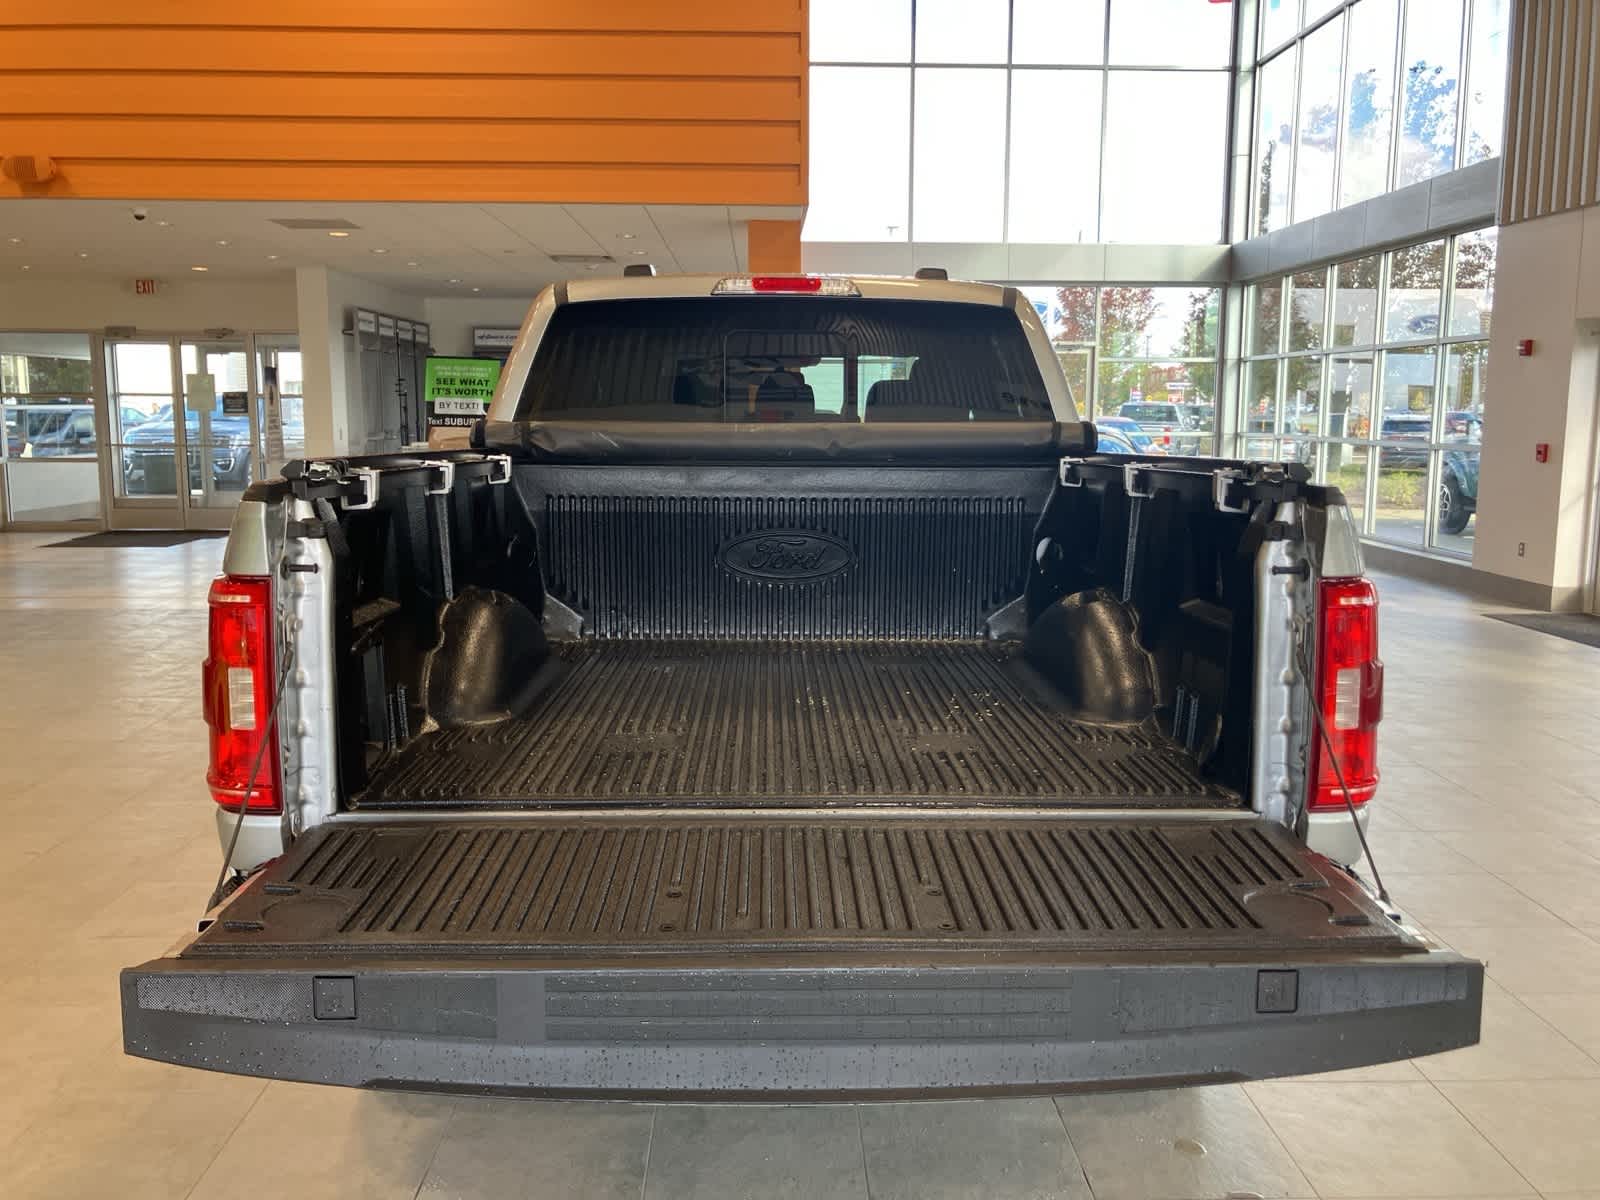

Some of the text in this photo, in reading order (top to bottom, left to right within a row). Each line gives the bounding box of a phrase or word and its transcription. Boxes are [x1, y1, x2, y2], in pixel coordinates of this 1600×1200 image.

[135, 279, 154, 295] EXIT
[435, 377, 490, 387] SEE WHAT
[431, 387, 494, 396] IT'S WORTH
[439, 401, 479, 410] BY TEXT!
[427, 417, 481, 426] Text SUBUR
[745, 538, 827, 570] Ford
